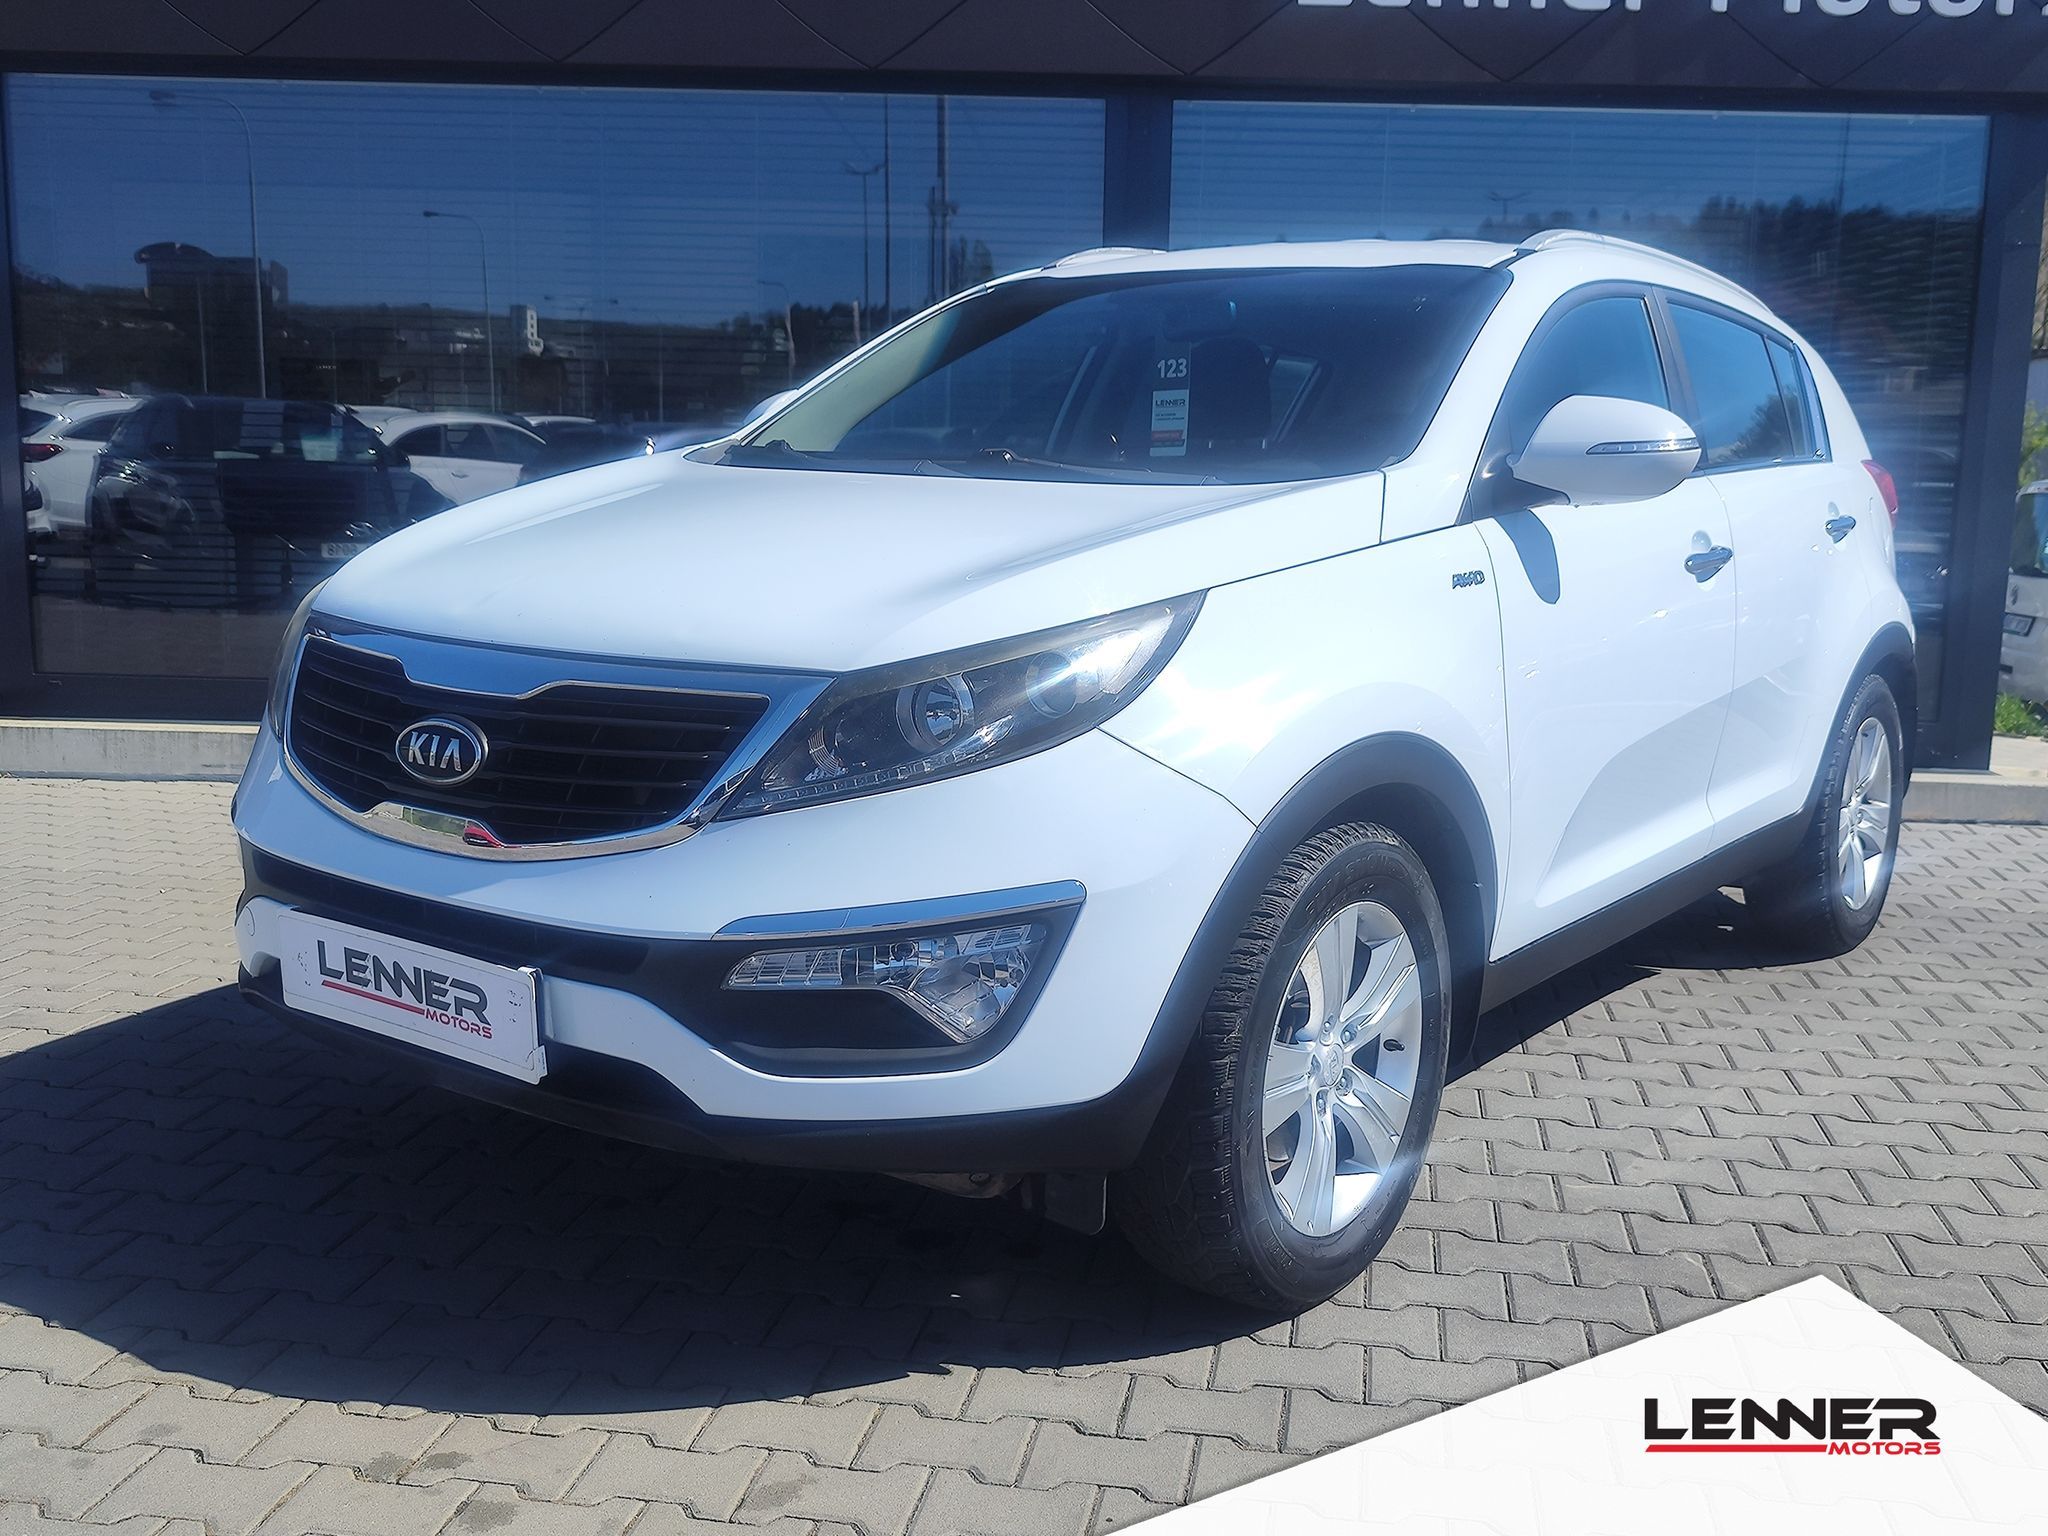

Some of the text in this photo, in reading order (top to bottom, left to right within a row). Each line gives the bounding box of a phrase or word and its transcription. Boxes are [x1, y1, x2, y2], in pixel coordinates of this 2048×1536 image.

[1157, 358, 1188, 378] 123
[408, 731, 462, 772] KIA
[317, 939, 492, 1027] LENNER
[425, 1008, 493, 1040] MOTORS
